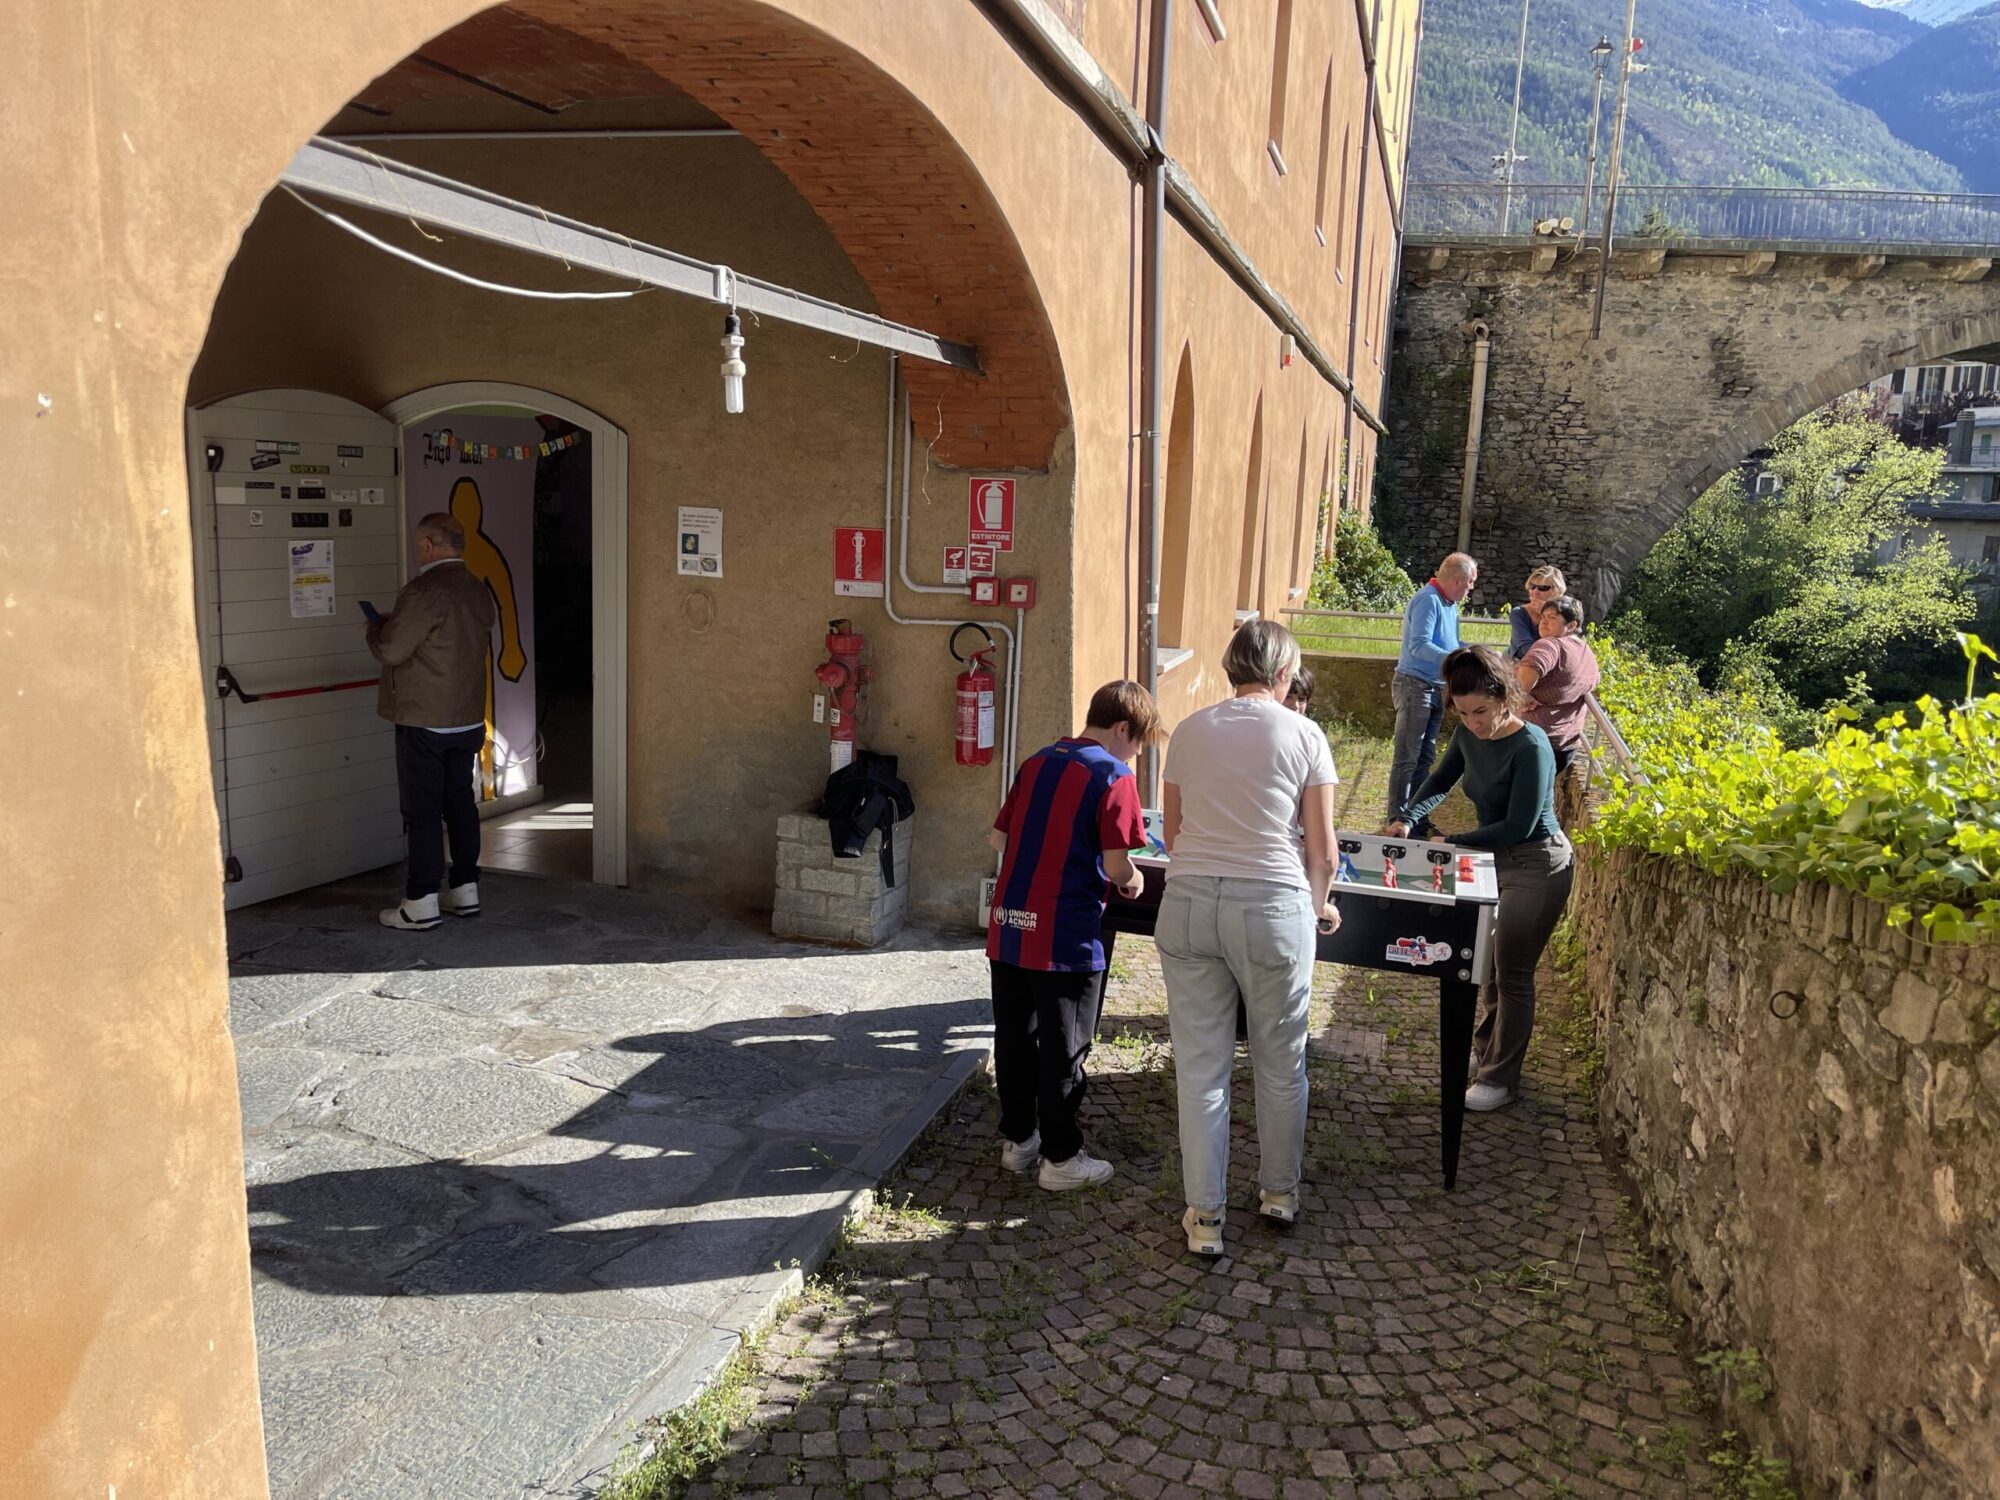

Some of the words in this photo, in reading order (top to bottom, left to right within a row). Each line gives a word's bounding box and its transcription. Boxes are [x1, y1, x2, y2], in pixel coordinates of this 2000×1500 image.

[971, 533, 1011, 541] ESTINTORE
[1008, 909, 1038, 921] UNHCR
[1008, 917, 1037, 928] ACNUR
